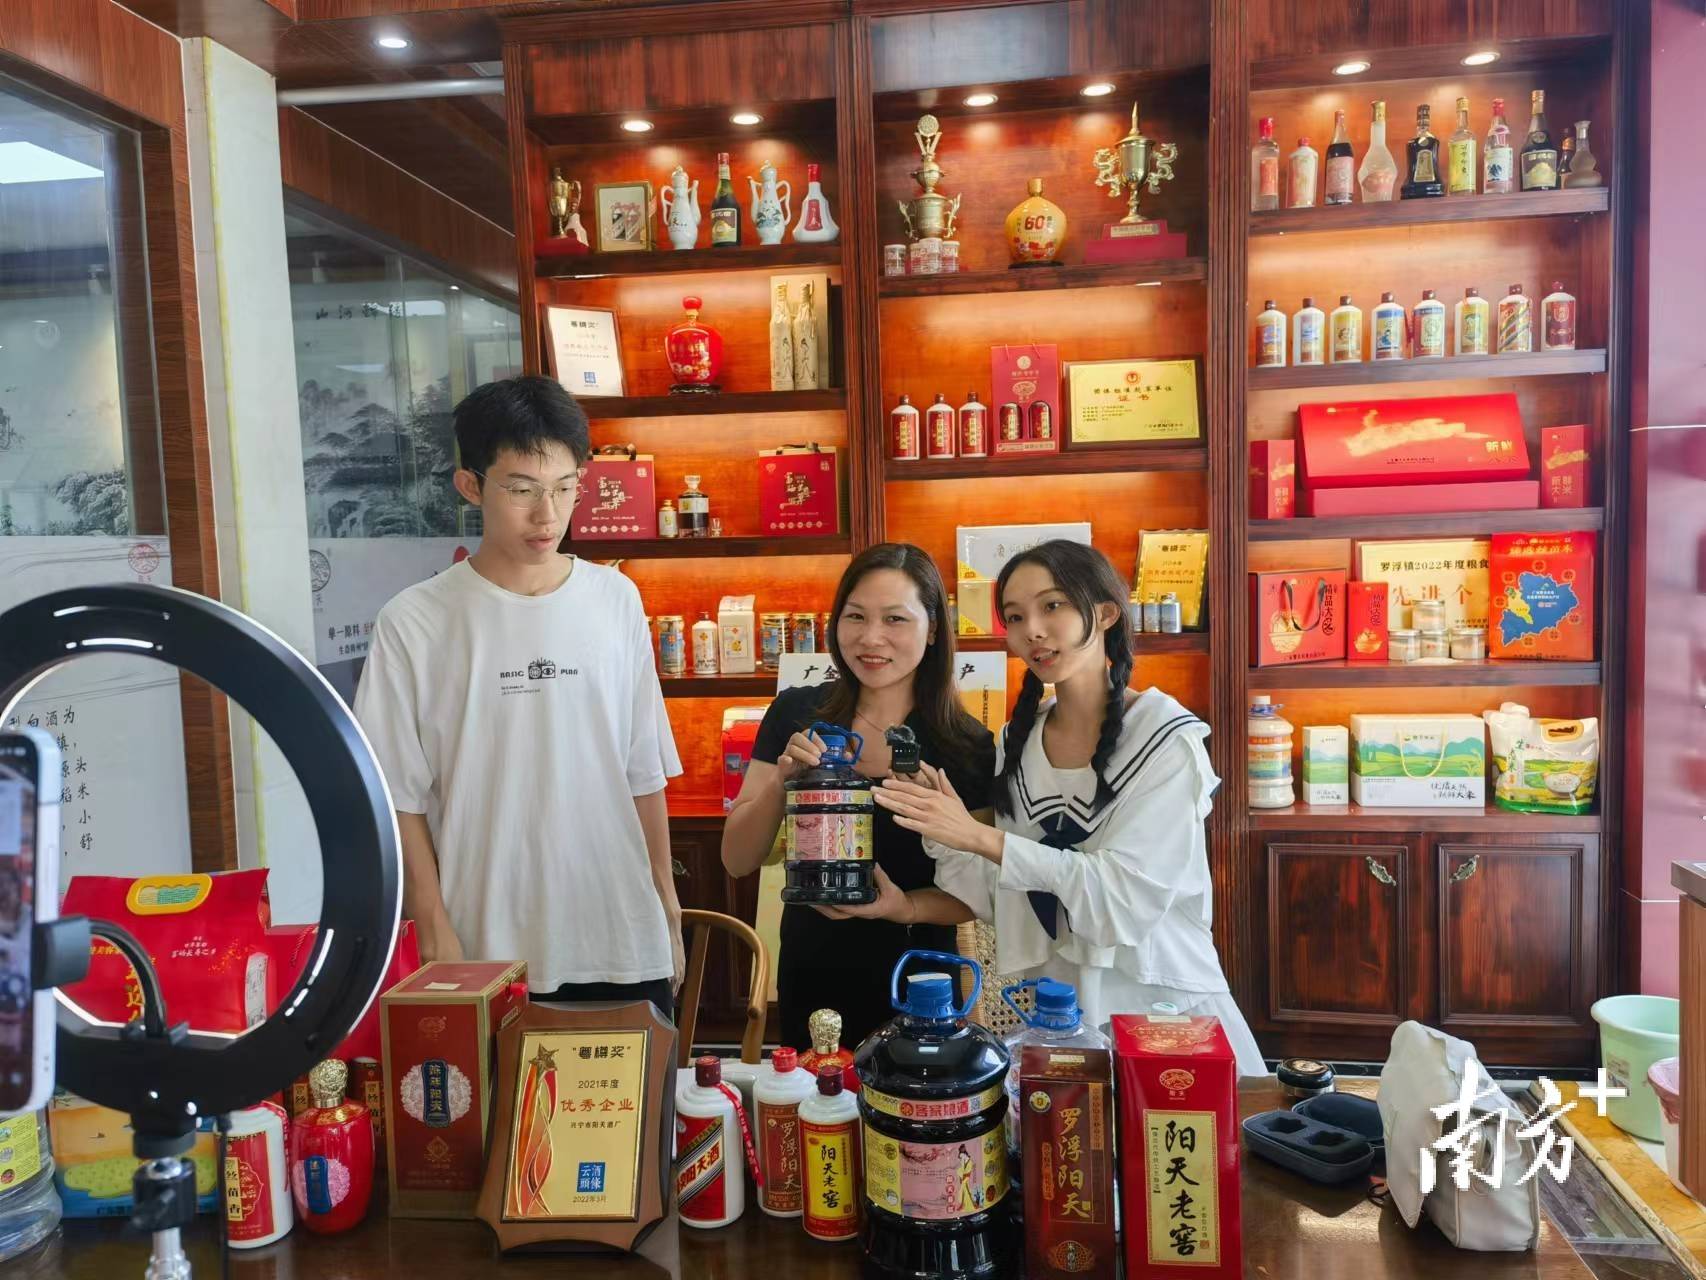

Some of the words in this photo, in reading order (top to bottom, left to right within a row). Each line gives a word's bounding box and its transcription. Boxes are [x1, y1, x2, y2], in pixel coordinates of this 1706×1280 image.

[1025, 215, 1045, 230] 60
[561, 1098, 635, 1113] 优秀企业
[578, 1079, 620, 1089] 2021年度
[780, 1121, 801, 1190] 罗浮阳天
[821, 1145, 840, 1209] 阳天老窖
[1058, 1107, 1090, 1218] 罗浮阳天
[1164, 1120, 1200, 1257] 阳天老窖
